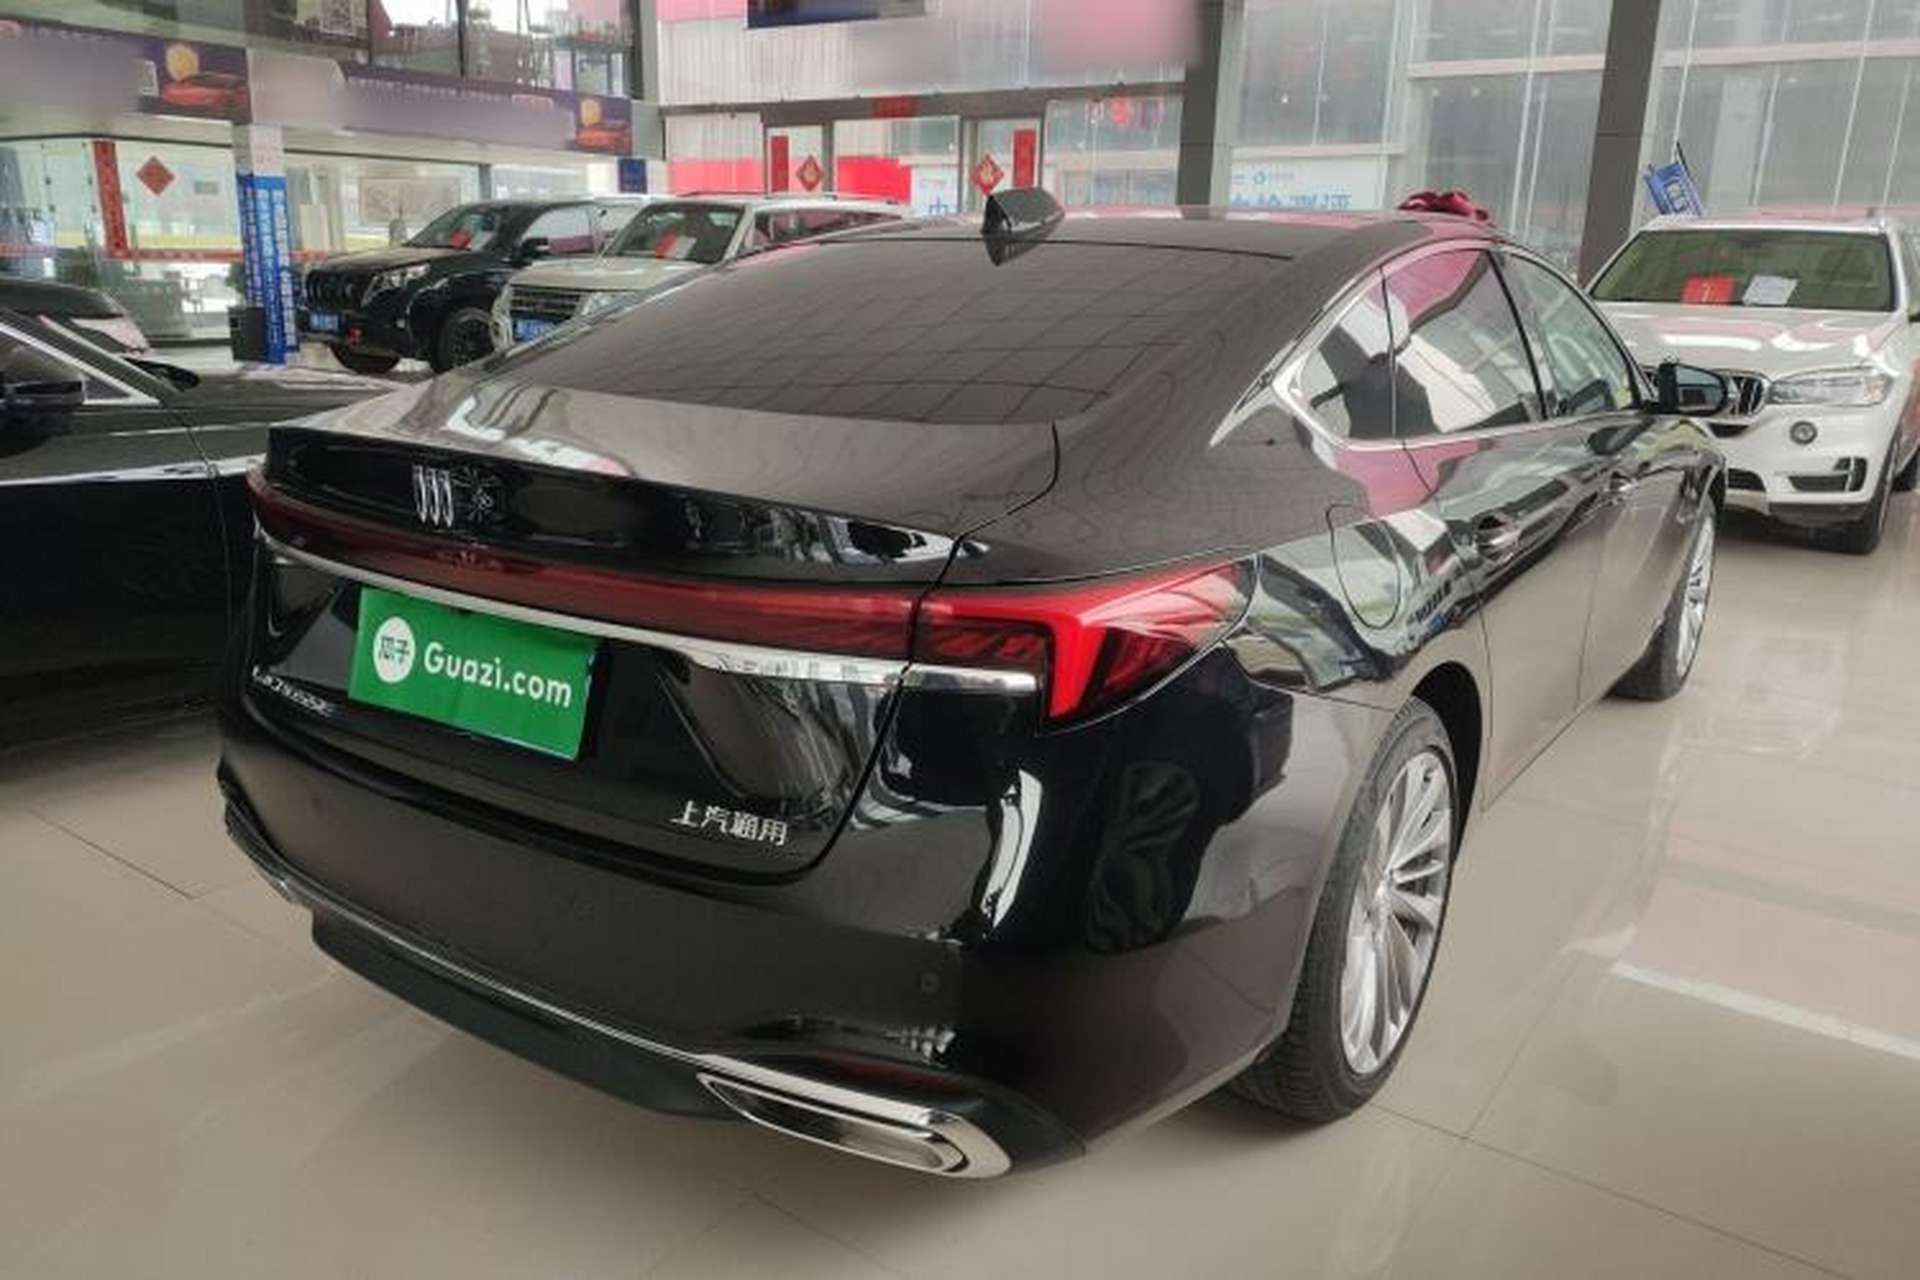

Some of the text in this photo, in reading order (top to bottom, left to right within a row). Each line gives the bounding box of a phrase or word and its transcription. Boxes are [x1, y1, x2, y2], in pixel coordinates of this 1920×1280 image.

[423, 641, 573, 708] Guazi.com
[670, 800, 787, 846] 上汽通用
